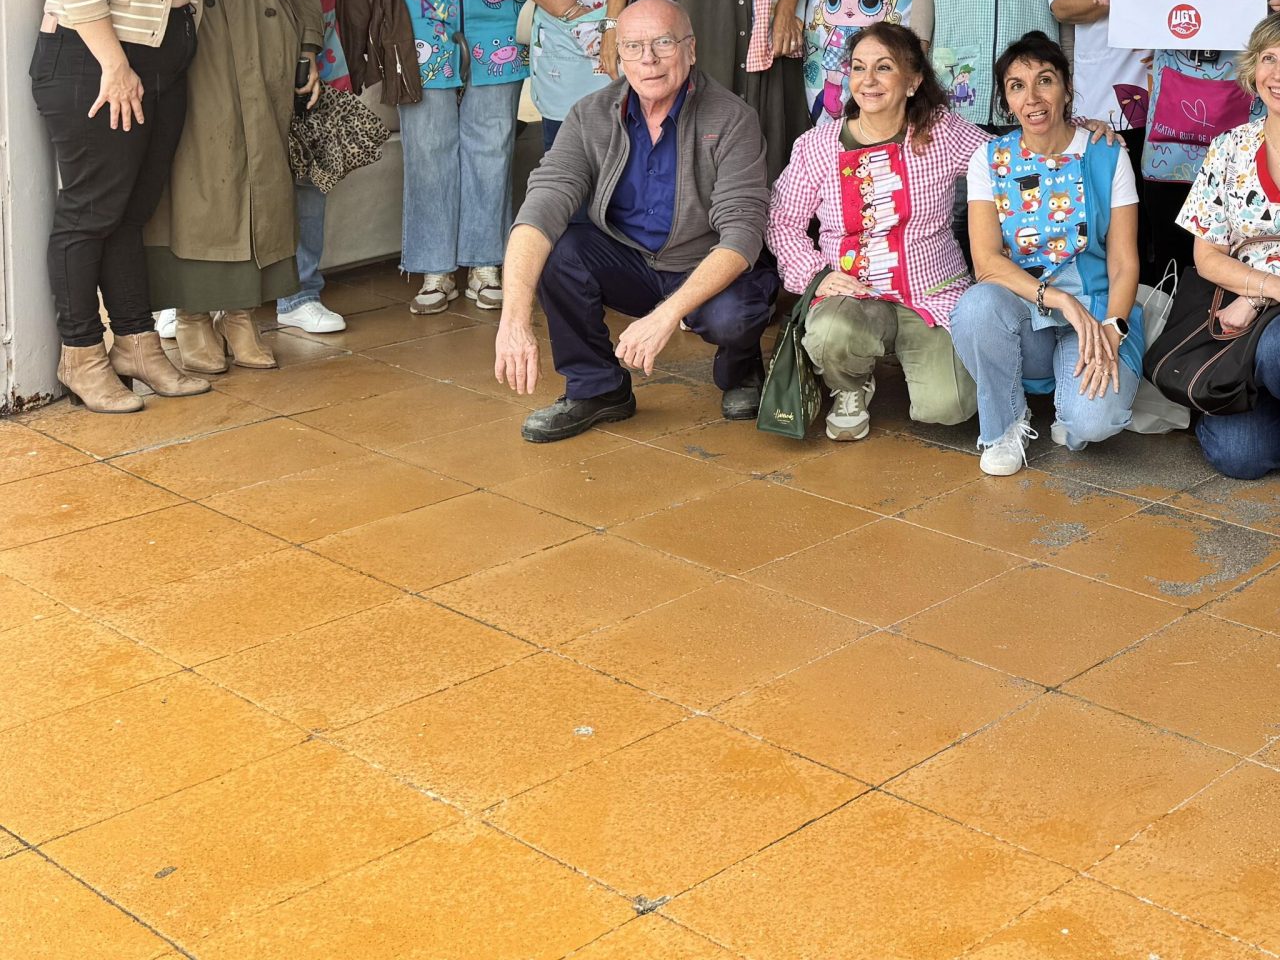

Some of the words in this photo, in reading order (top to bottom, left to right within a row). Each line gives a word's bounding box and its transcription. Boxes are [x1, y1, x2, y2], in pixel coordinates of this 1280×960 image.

[1171, 10, 1197, 24] UGT
[1198, 134, 1206, 143] DE
[1016, 164, 1037, 172] OWL
[1044, 174, 1075, 186] OWL
[1021, 216, 1040, 224] OWL
[1044, 225, 1067, 233] OWL
